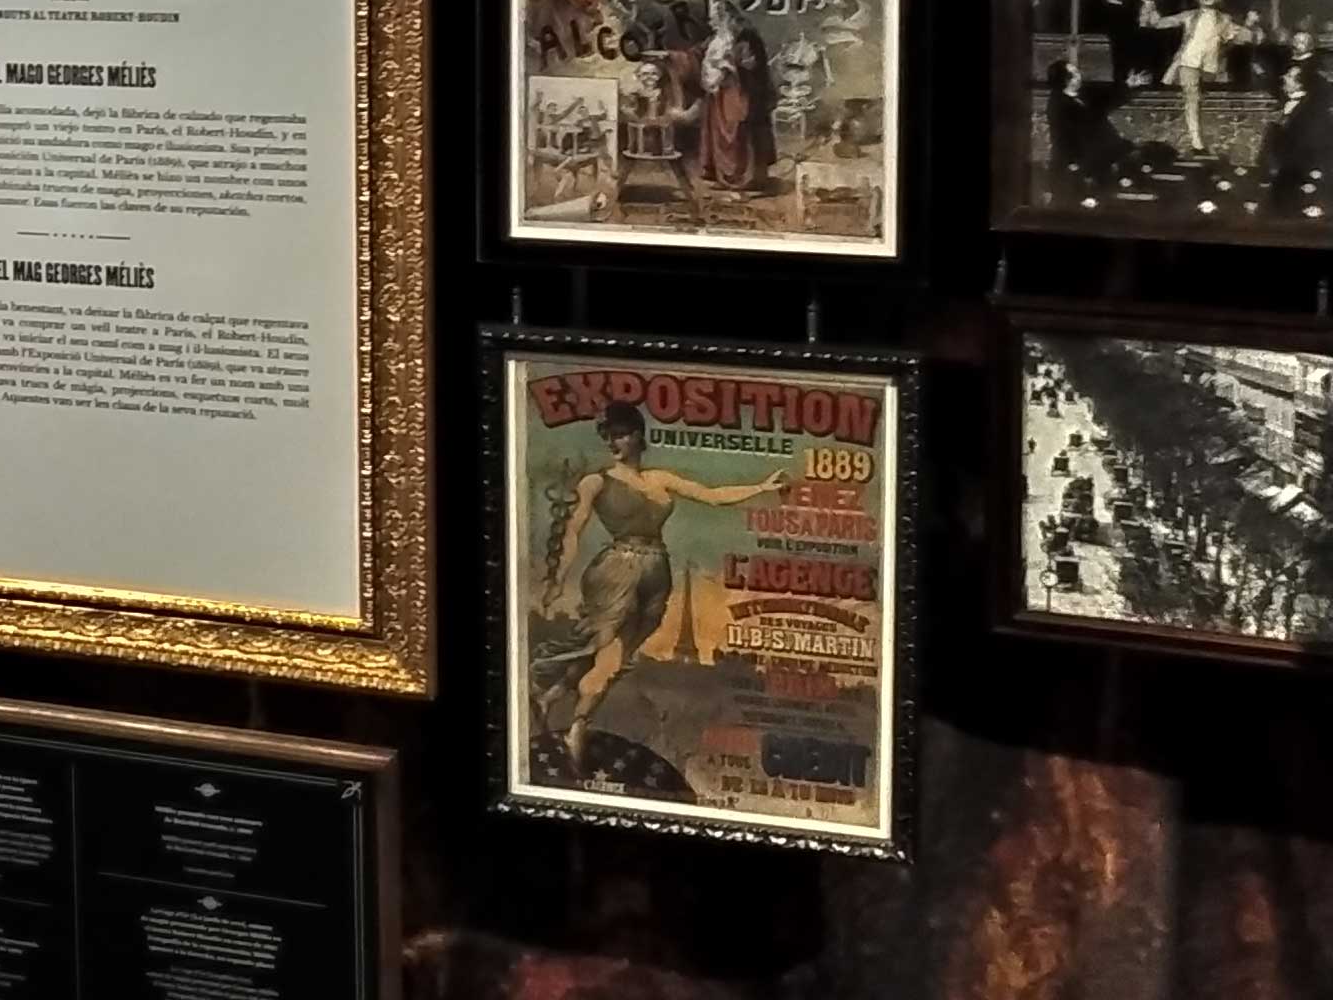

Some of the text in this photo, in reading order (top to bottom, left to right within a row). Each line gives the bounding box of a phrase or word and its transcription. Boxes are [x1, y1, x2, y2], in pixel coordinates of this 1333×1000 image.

[5, 63, 43, 85] MAGO
[47, 64, 104, 86] GEORGES
[107, 60, 157, 88] MÉLIÈS
[13, 261, 42, 282] MAG
[46, 263, 102, 286] GEORGES
[105, 261, 155, 289] MÉLIÈS
[530, 371, 877, 447] EXPOSITION
[649, 427, 794, 456] UNIVERSELLE
[803, 447, 875, 484] 1889
